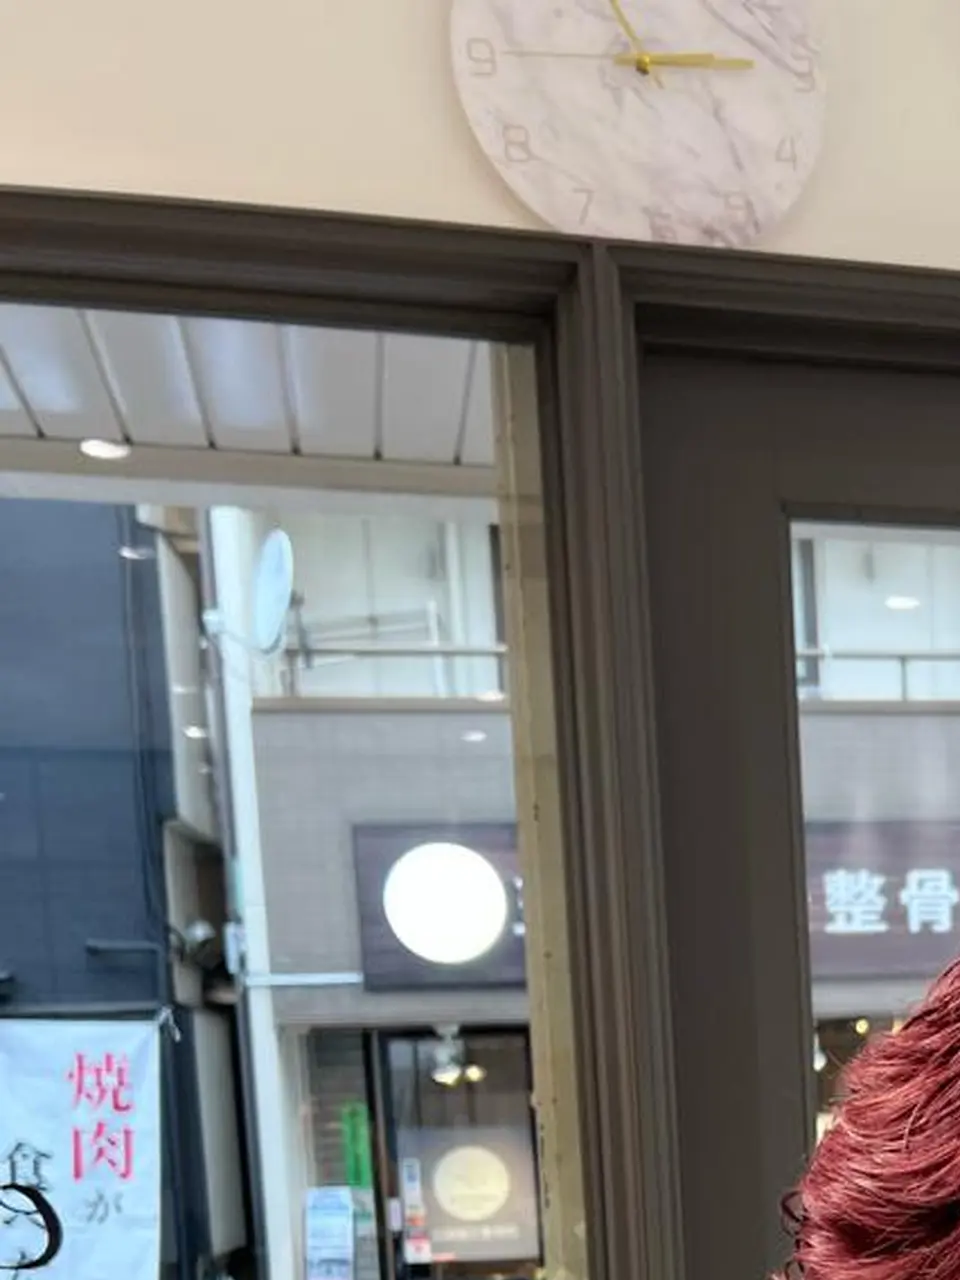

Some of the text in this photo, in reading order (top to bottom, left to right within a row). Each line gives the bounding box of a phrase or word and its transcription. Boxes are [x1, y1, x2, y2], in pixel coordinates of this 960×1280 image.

[503, 124, 530, 162] 8
[775, 136, 797, 171] 4
[572, 187, 594, 225] 7
